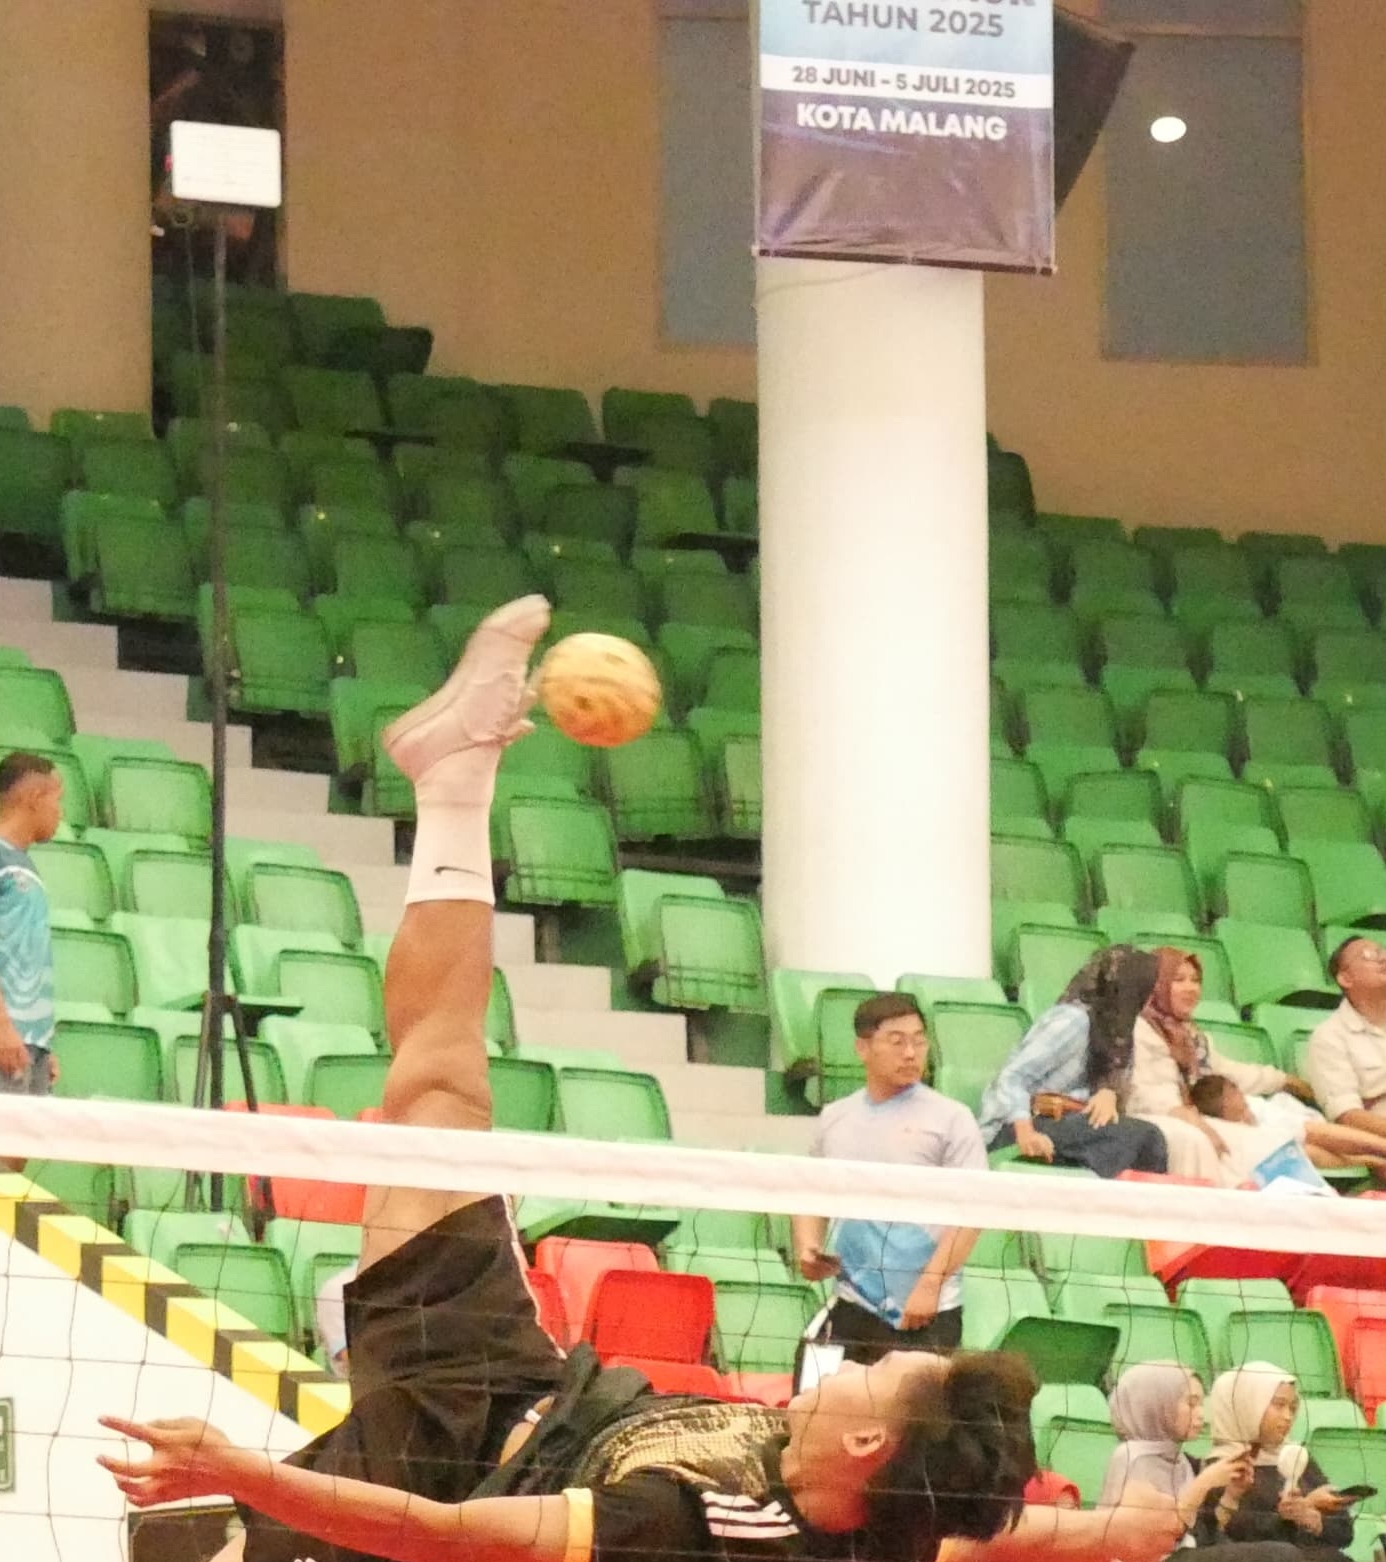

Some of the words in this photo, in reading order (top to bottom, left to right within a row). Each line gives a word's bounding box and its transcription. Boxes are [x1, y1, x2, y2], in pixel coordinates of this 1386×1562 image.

[802, 0, 918, 31] TAHUN
[929, 9, 1004, 37] 2025
[792, 66, 818, 84] 28
[822, 67, 875, 88] JUNI
[896, 73, 908, 90] 5
[912, 75, 960, 94] JULI
[965, 78, 1016, 99] 2025
[797, 103, 876, 132] KOTA
[880, 108, 1008, 141] MALANG
